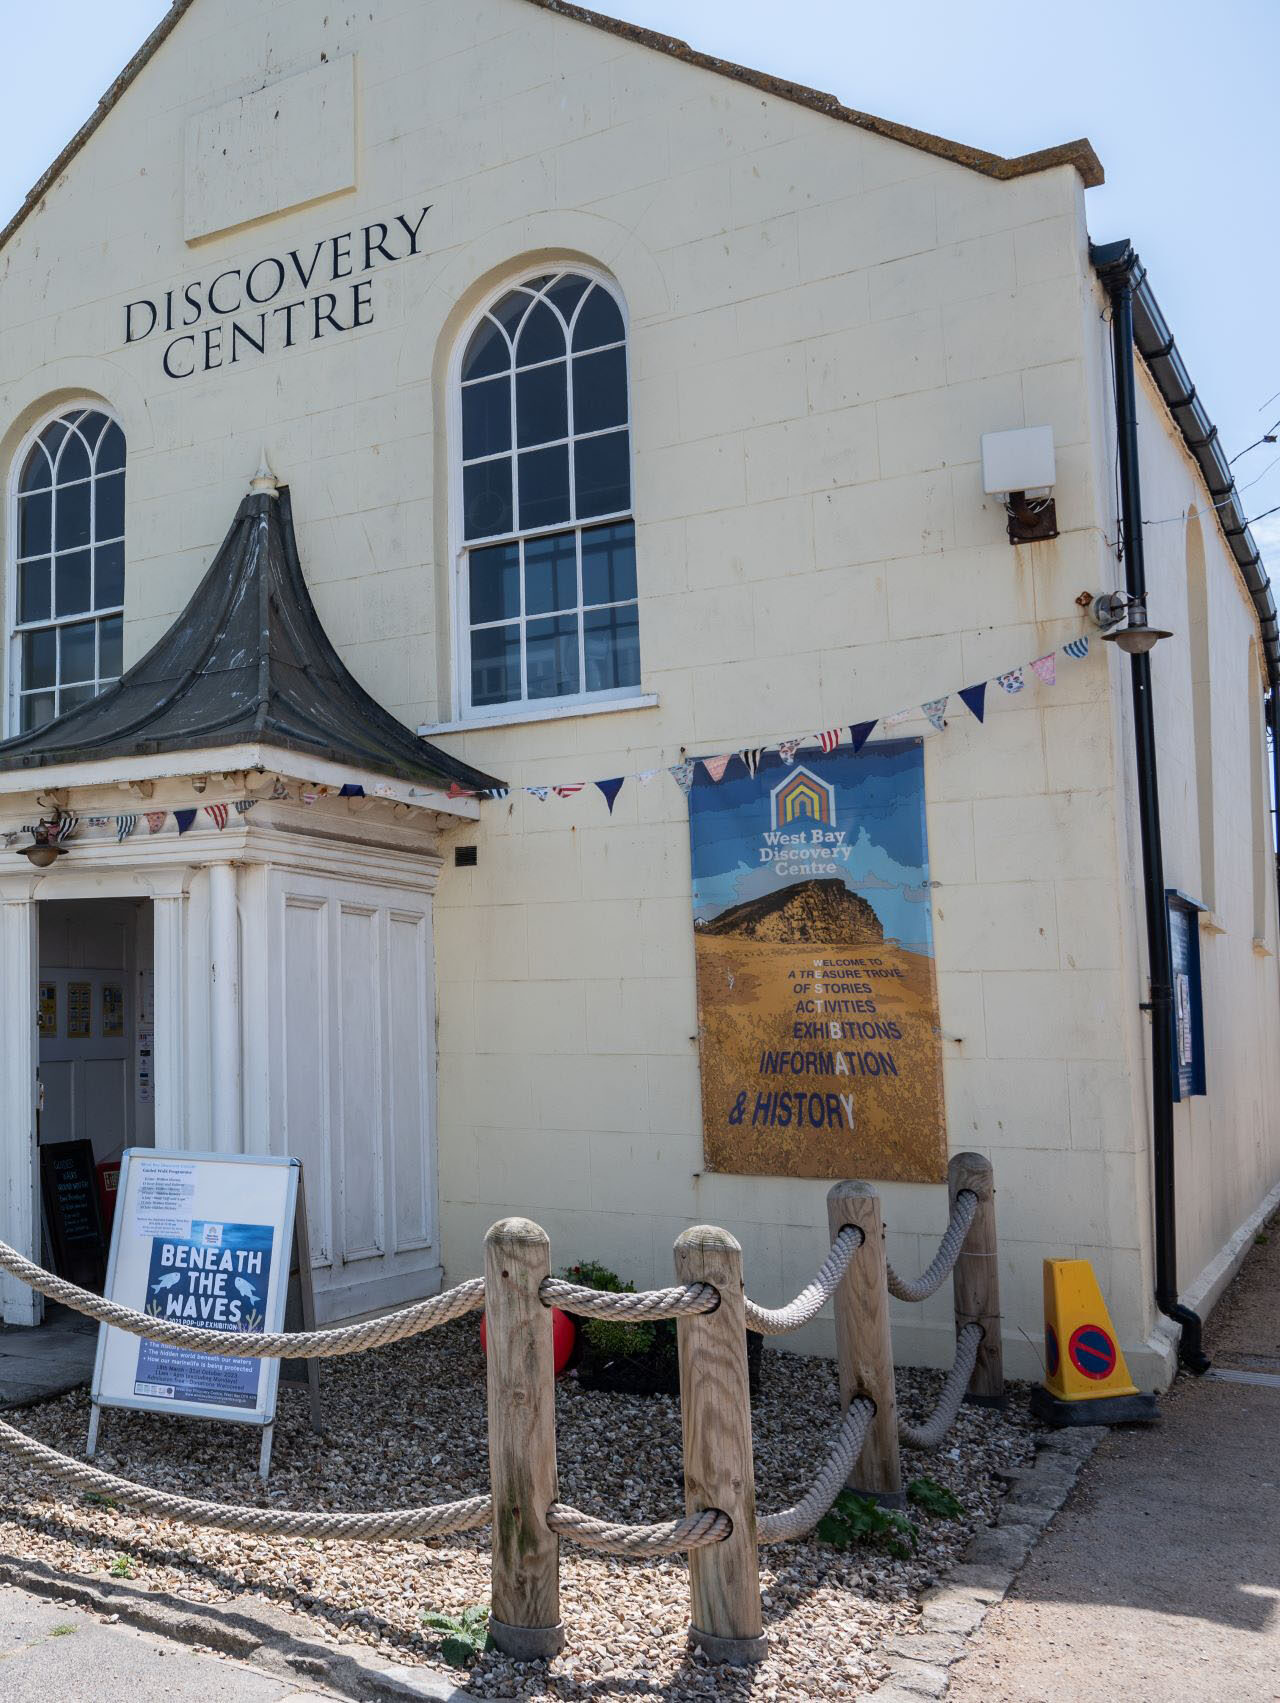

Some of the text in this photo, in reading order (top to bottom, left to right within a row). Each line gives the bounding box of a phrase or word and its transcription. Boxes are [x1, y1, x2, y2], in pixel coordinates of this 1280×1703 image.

[123, 204, 434, 344] DISCOVERY
[162, 280, 374, 379] CENTRE
[762, 829, 846, 845] West Bay
[759, 847, 853, 862] Discovery
[775, 861, 837, 876] Centre
[813, 958, 883, 967] WELCOME TO
[788, 968, 904, 979] A TREASURE TROVE
[793, 983, 873, 994] OF STORIES
[795, 999, 877, 1013] ACTIVITIES
[793, 1021, 902, 1040] EXHIBITIONS
[759, 1051, 898, 1076] INFORMATION
[728, 1090, 854, 1130] & HISTORY
[160, 1244, 263, 1274] BENEATH
[188, 1271, 228, 1296] THE
[166, 1293, 242, 1322] WAVES
[182, 1318, 205, 1327] POP-UP
[205, 1321, 237, 1330] EXHIBITION
[180, 1352, 196, 1360] world
[197, 1353, 220, 1362] beneath
[207, 1362, 223, 1371] being
[224, 1364, 253, 1373] protected
